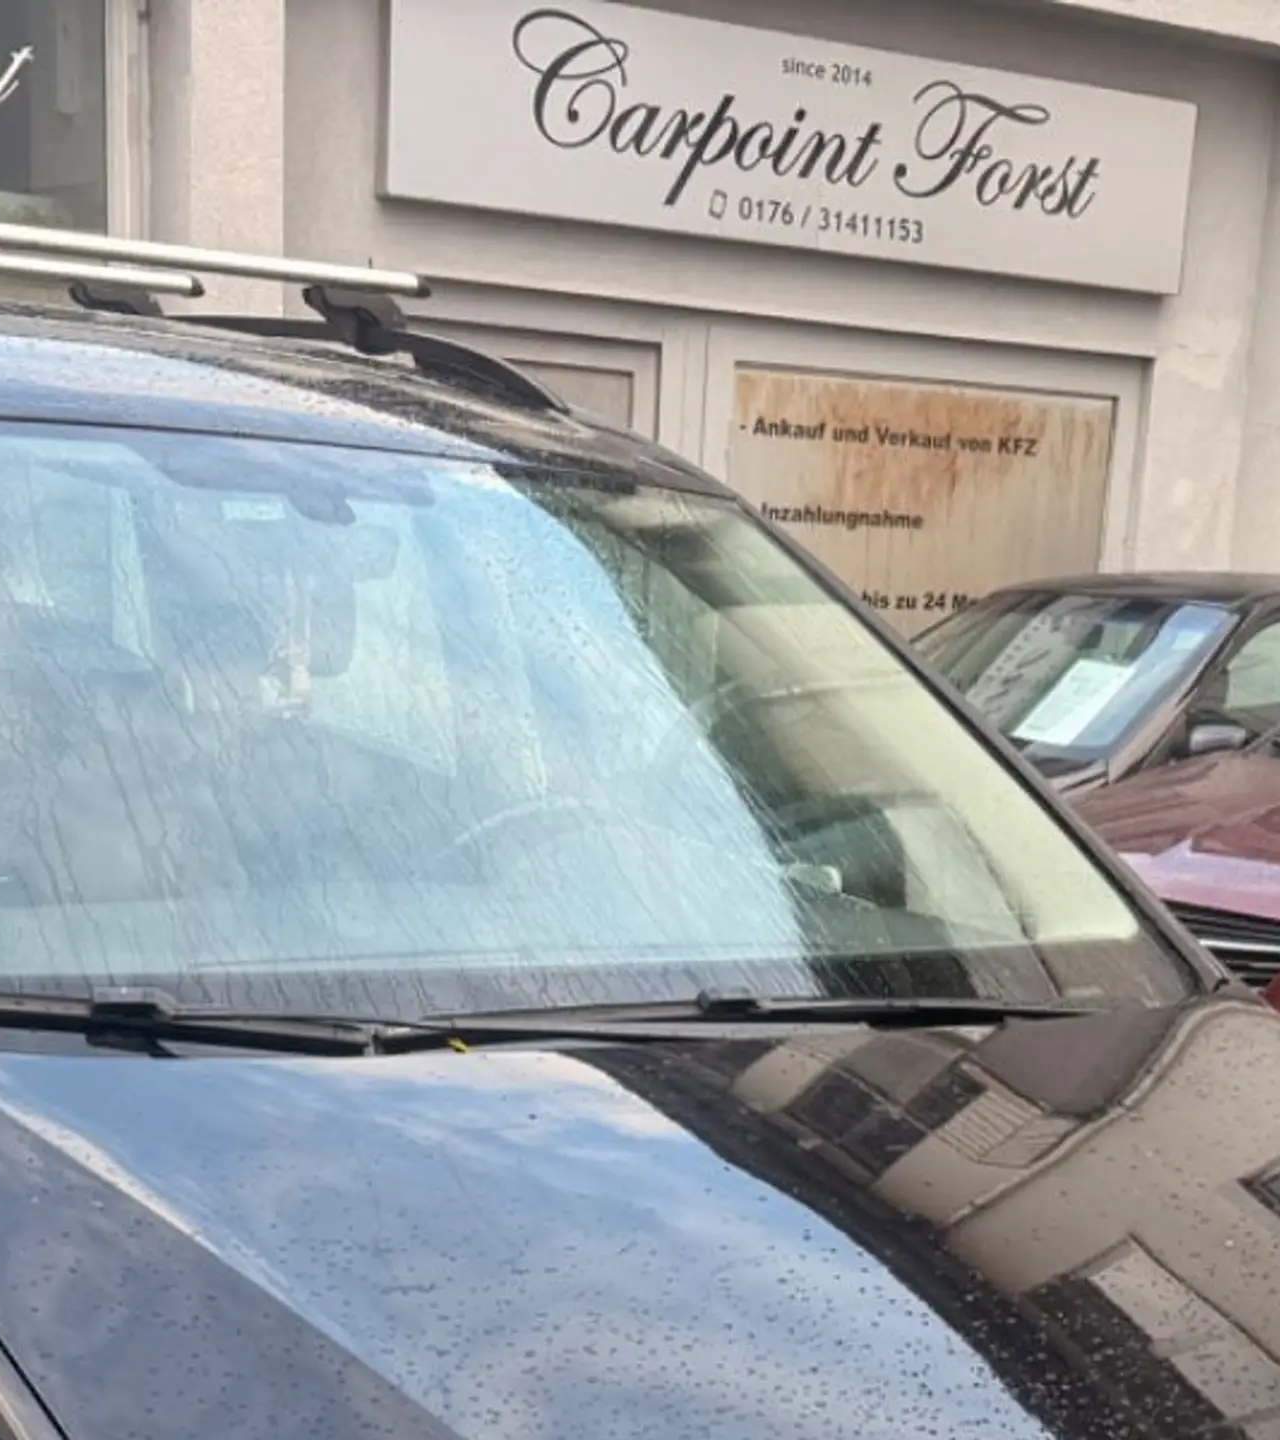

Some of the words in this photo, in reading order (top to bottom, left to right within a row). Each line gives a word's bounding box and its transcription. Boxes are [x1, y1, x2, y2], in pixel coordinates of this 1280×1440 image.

[781, 57, 826, 79] since
[831, 62, 872, 87] 2014
[512, 8, 882, 207] Carpoint
[893, 80, 1102, 219] Forst
[738, 196, 795, 227] 0176
[817, 207, 926, 244] 31411153
[752, 416, 826, 441] Ankauf
[832, 426, 870, 445] und
[875, 426, 952, 451] Verkauf
[957, 437, 992, 454] von
[997, 437, 1039, 457] KFZ
[761, 502, 925, 531] Inzahlungnahme
[896, 595, 917, 611] zu
[923, 591, 947, 612] 24
